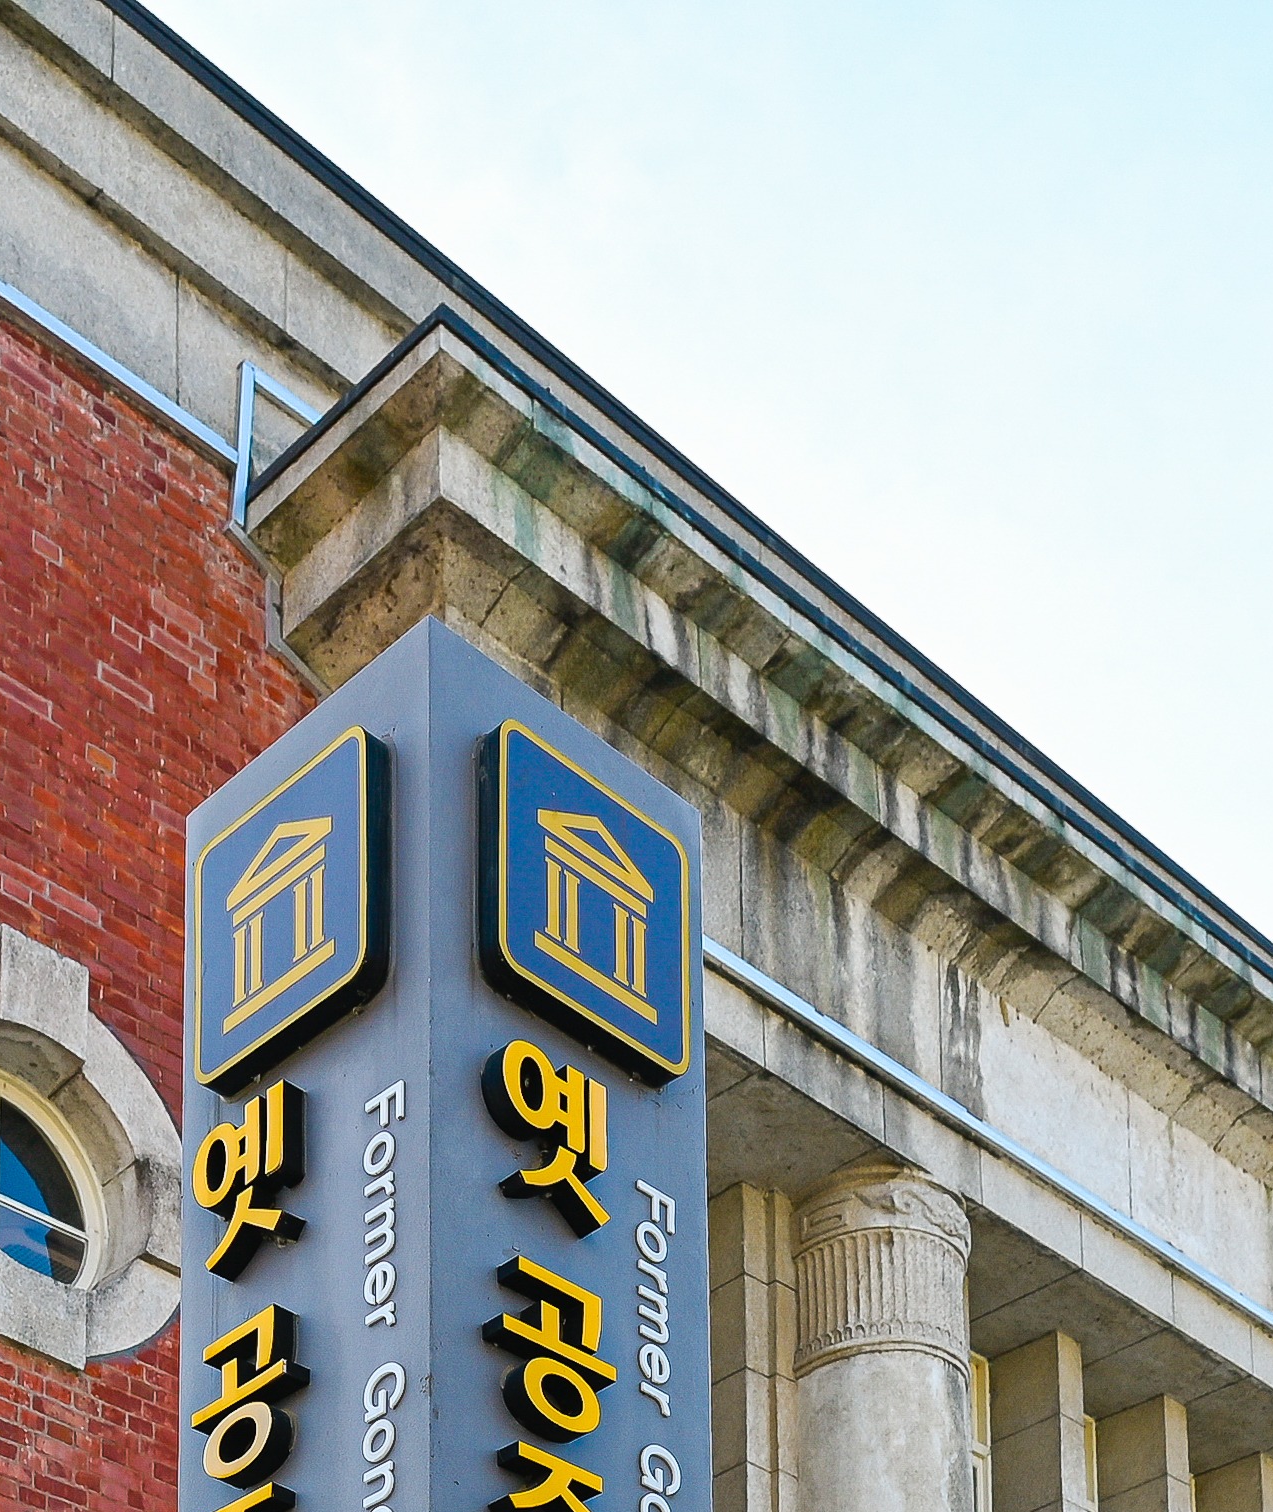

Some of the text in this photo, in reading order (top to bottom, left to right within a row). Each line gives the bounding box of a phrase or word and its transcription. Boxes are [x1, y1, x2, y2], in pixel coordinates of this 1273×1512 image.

[191, 1079, 307, 1283] 옛
[363, 1080, 406, 1327] Former
[480, 1039, 611, 1239] 옛
[634, 1179, 677, 1416] Former
